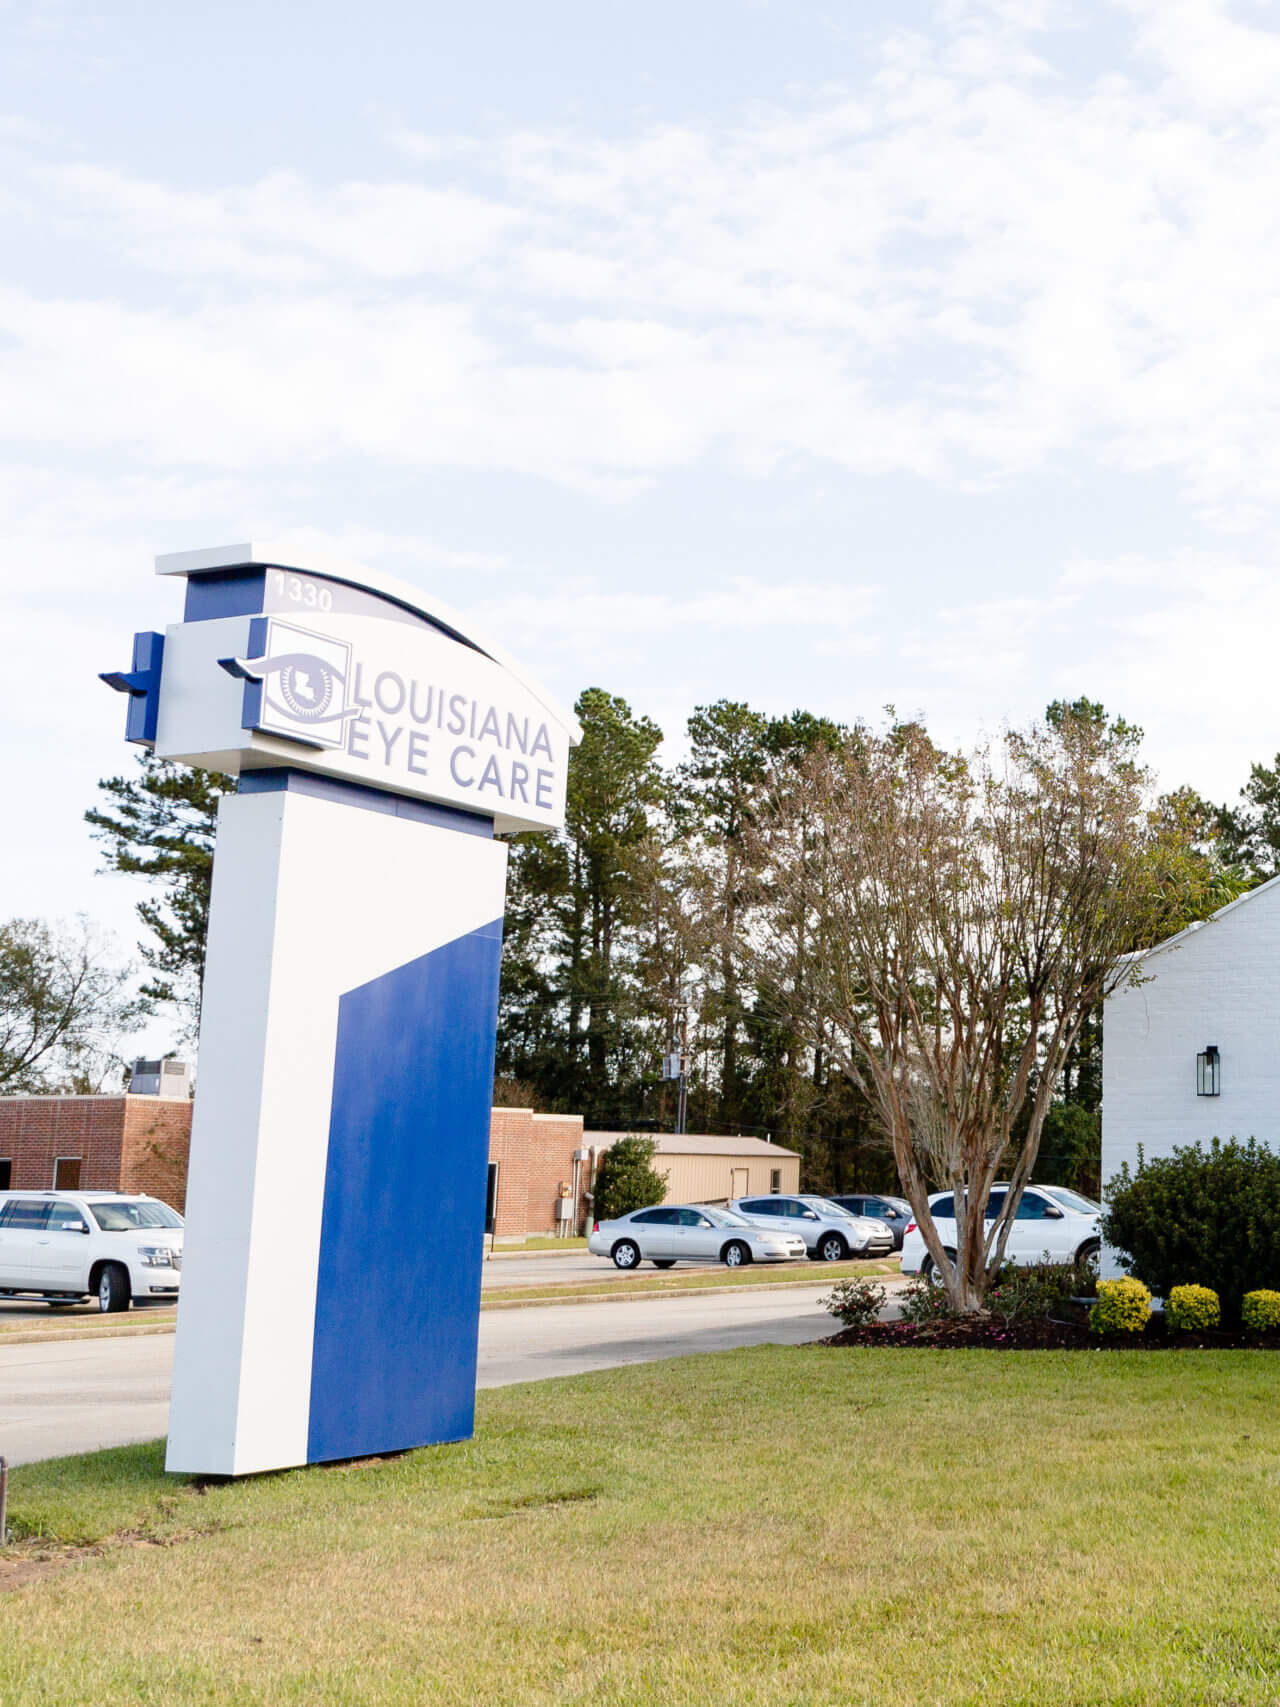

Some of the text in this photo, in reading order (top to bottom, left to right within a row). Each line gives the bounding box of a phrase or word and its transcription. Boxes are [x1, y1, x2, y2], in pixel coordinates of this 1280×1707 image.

[275, 573, 332, 611] 1330
[354, 662, 554, 762] LOUISIANA
[349, 716, 555, 810] EYE CARE
